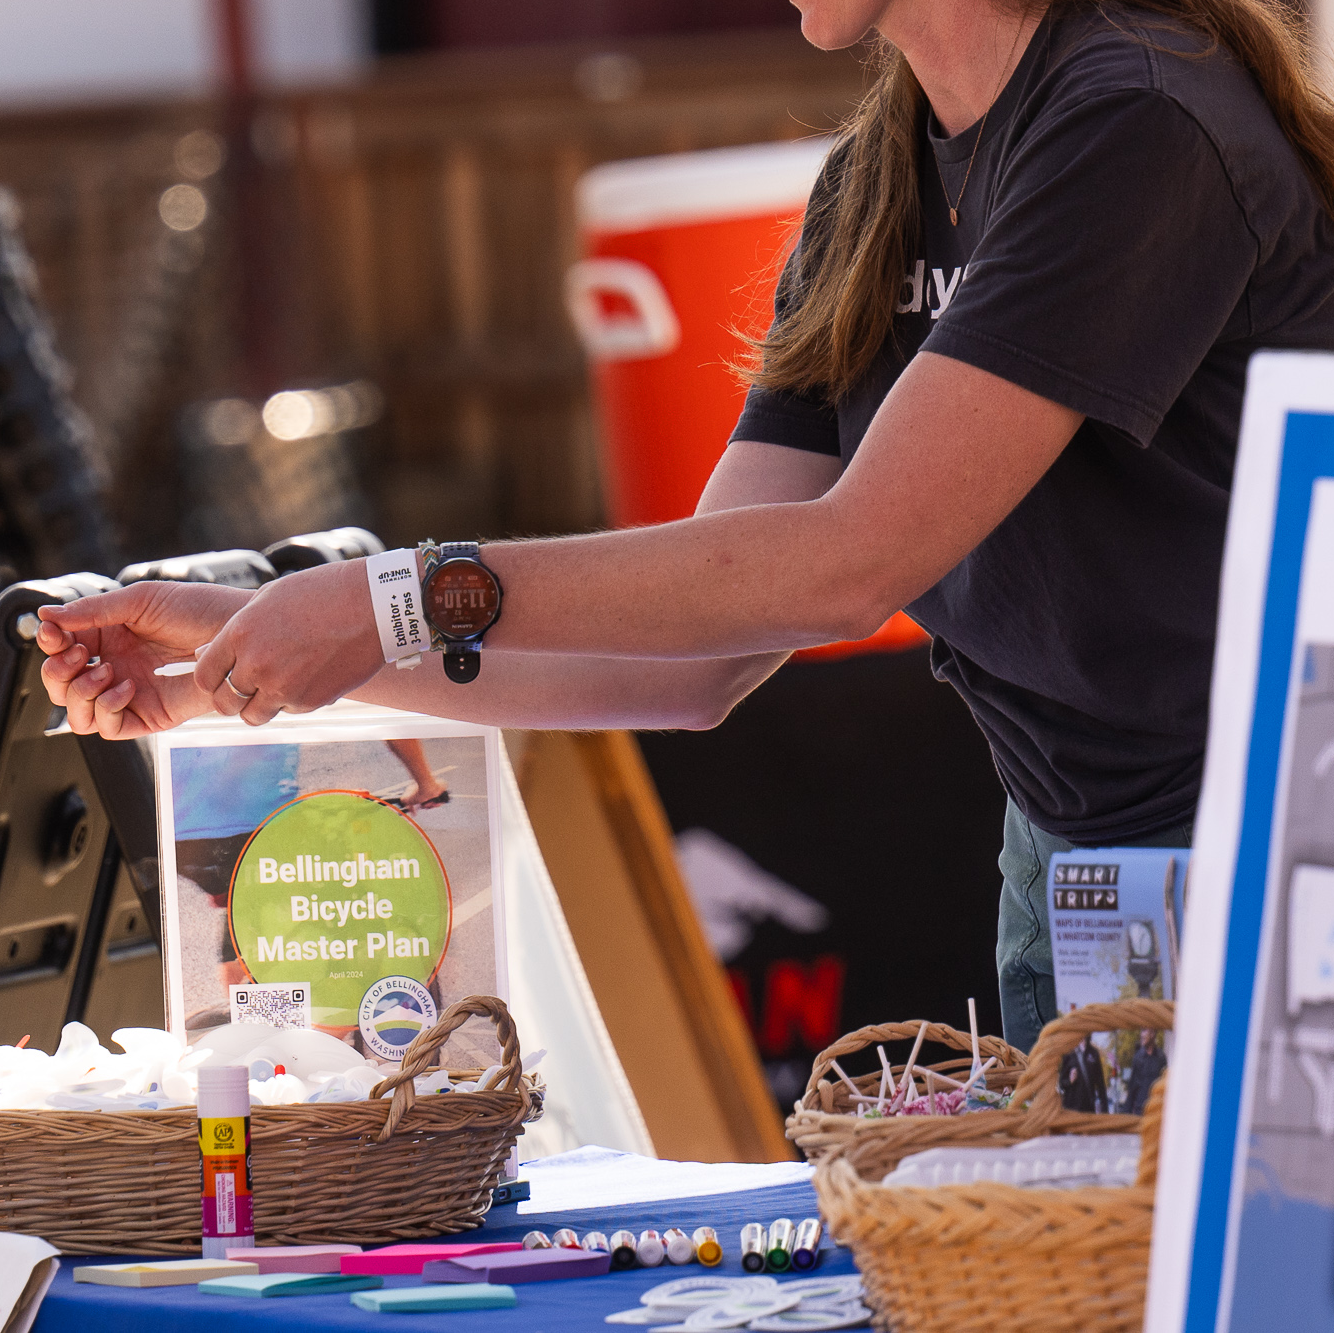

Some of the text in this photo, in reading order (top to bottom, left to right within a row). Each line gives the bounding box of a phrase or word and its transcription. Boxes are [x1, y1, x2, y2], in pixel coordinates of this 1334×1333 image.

[377, 567, 412, 580] TUNE-UP
[390, 603, 408, 647] Exhibitor
[403, 591, 422, 645] 3-Day Pass
[258, 852, 421, 888] Bellingham
[1055, 866, 1118, 884] SMART
[290, 891, 394, 928] Bicycle
[257, 930, 431, 963] Master Plan
[329, 970, 364, 980] April 2024
[362, 980, 433, 1021] CITY OF BELLINGHAM
[370, 1037, 409, 1057] WASHIN
